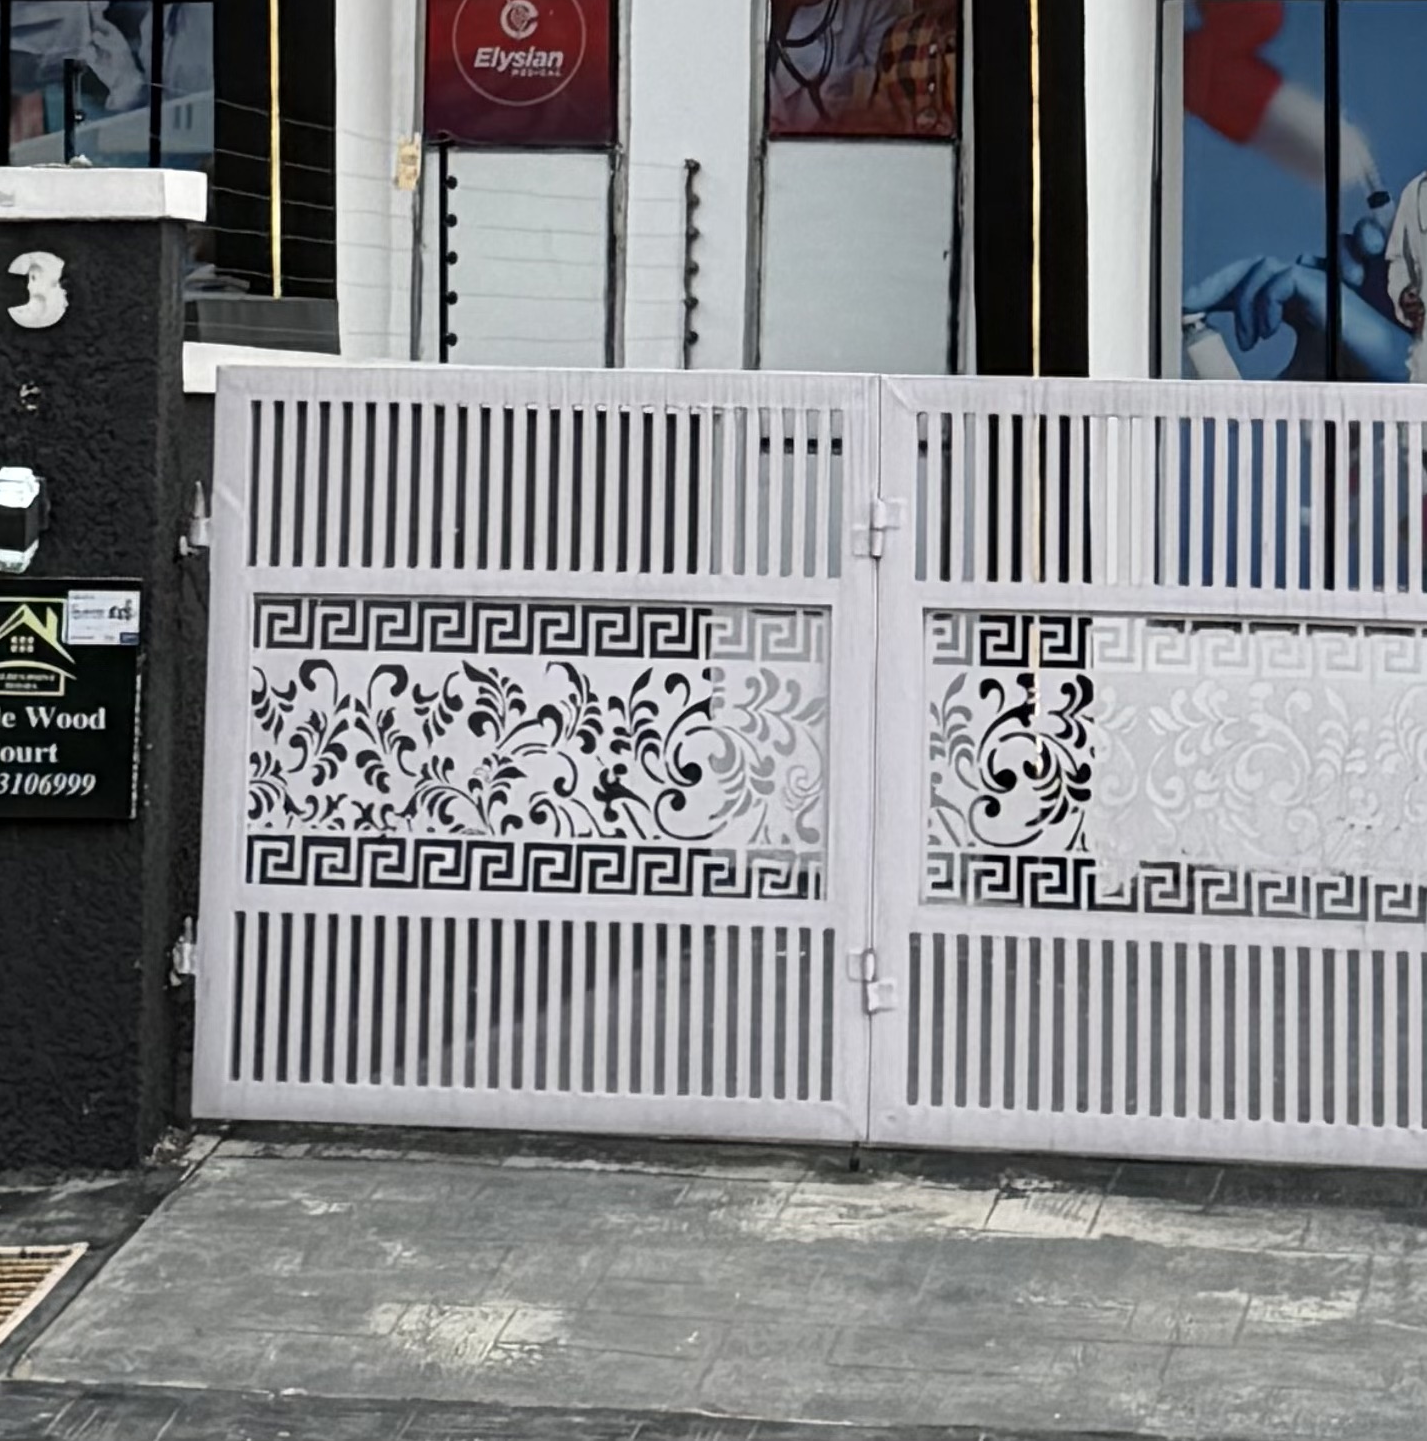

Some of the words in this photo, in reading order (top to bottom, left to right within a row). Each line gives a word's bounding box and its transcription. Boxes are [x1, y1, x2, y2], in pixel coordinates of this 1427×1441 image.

[474, 46, 564, 73] Elysian
[7, 250, 69, 329] 3
[25, 705, 107, 731] Wood
